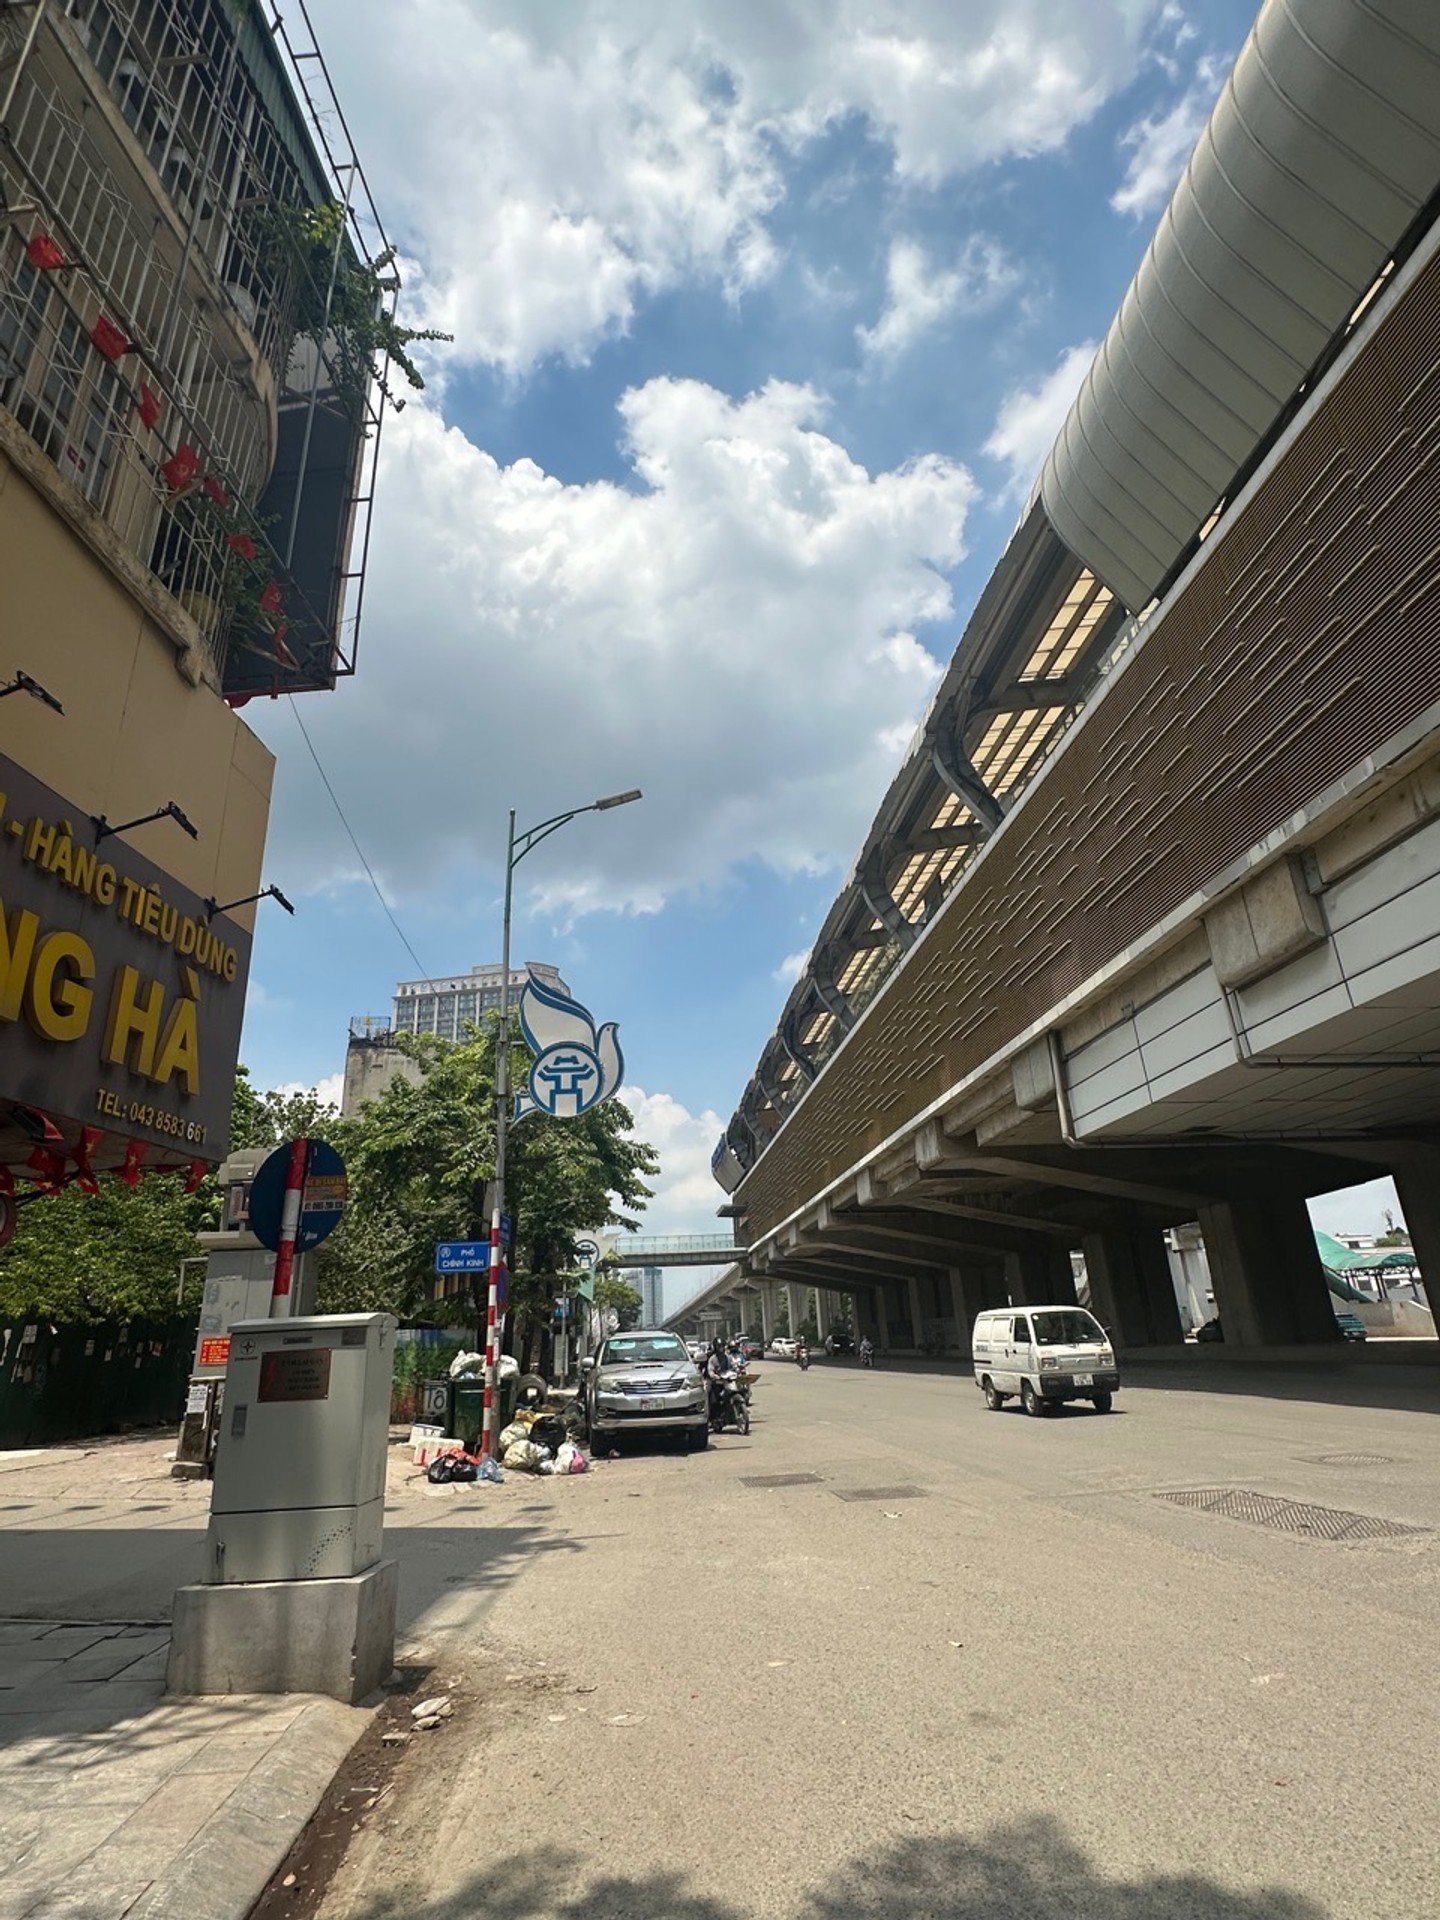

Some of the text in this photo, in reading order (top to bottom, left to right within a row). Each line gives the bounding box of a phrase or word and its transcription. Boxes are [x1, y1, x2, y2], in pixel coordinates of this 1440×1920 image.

[27, 816, 118, 906] HÀNG
[121, 876, 179, 944] TIÊU
[180, 914, 238, 983] DÙNG
[107, 964, 201, 1096] HÀ
[97, 1088, 208, 1145] TEL: 043 8583 661
[466, 1258, 485, 1267] KINH
